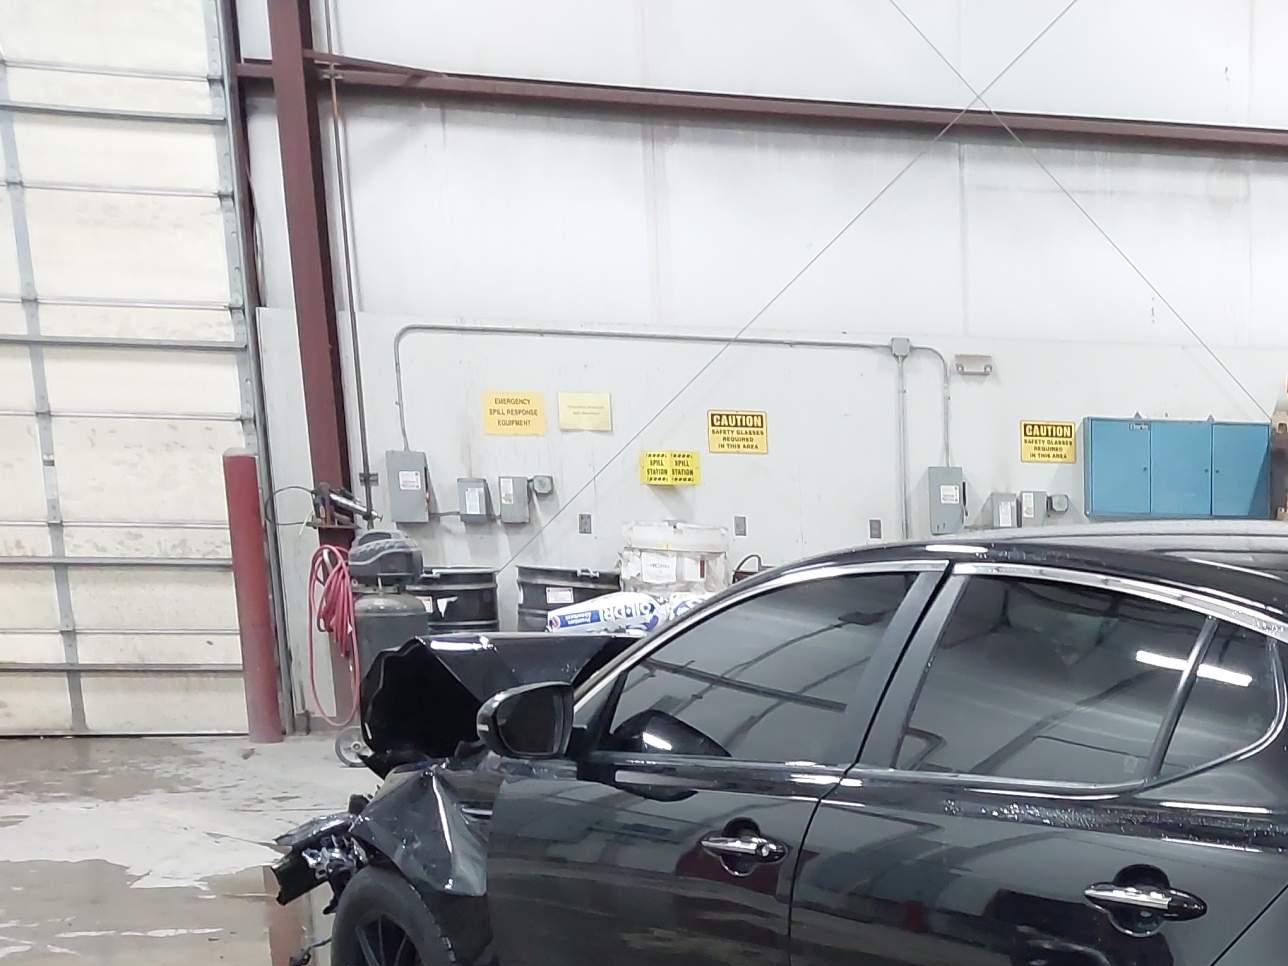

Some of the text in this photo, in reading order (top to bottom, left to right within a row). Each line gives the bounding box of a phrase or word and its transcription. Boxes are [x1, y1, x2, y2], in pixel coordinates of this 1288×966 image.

[494, 397, 531, 405] EMERGENCY
[489, 408, 539, 416] SPILL RESPONSE
[713, 414, 762, 427] CAUTION
[1025, 425, 1072, 437] CAUTION
[650, 459, 664, 467] SPILL
[674, 459, 690, 467] SPILL
[646, 468, 668, 476] STATION
[671, 468, 694, 476] STATION
